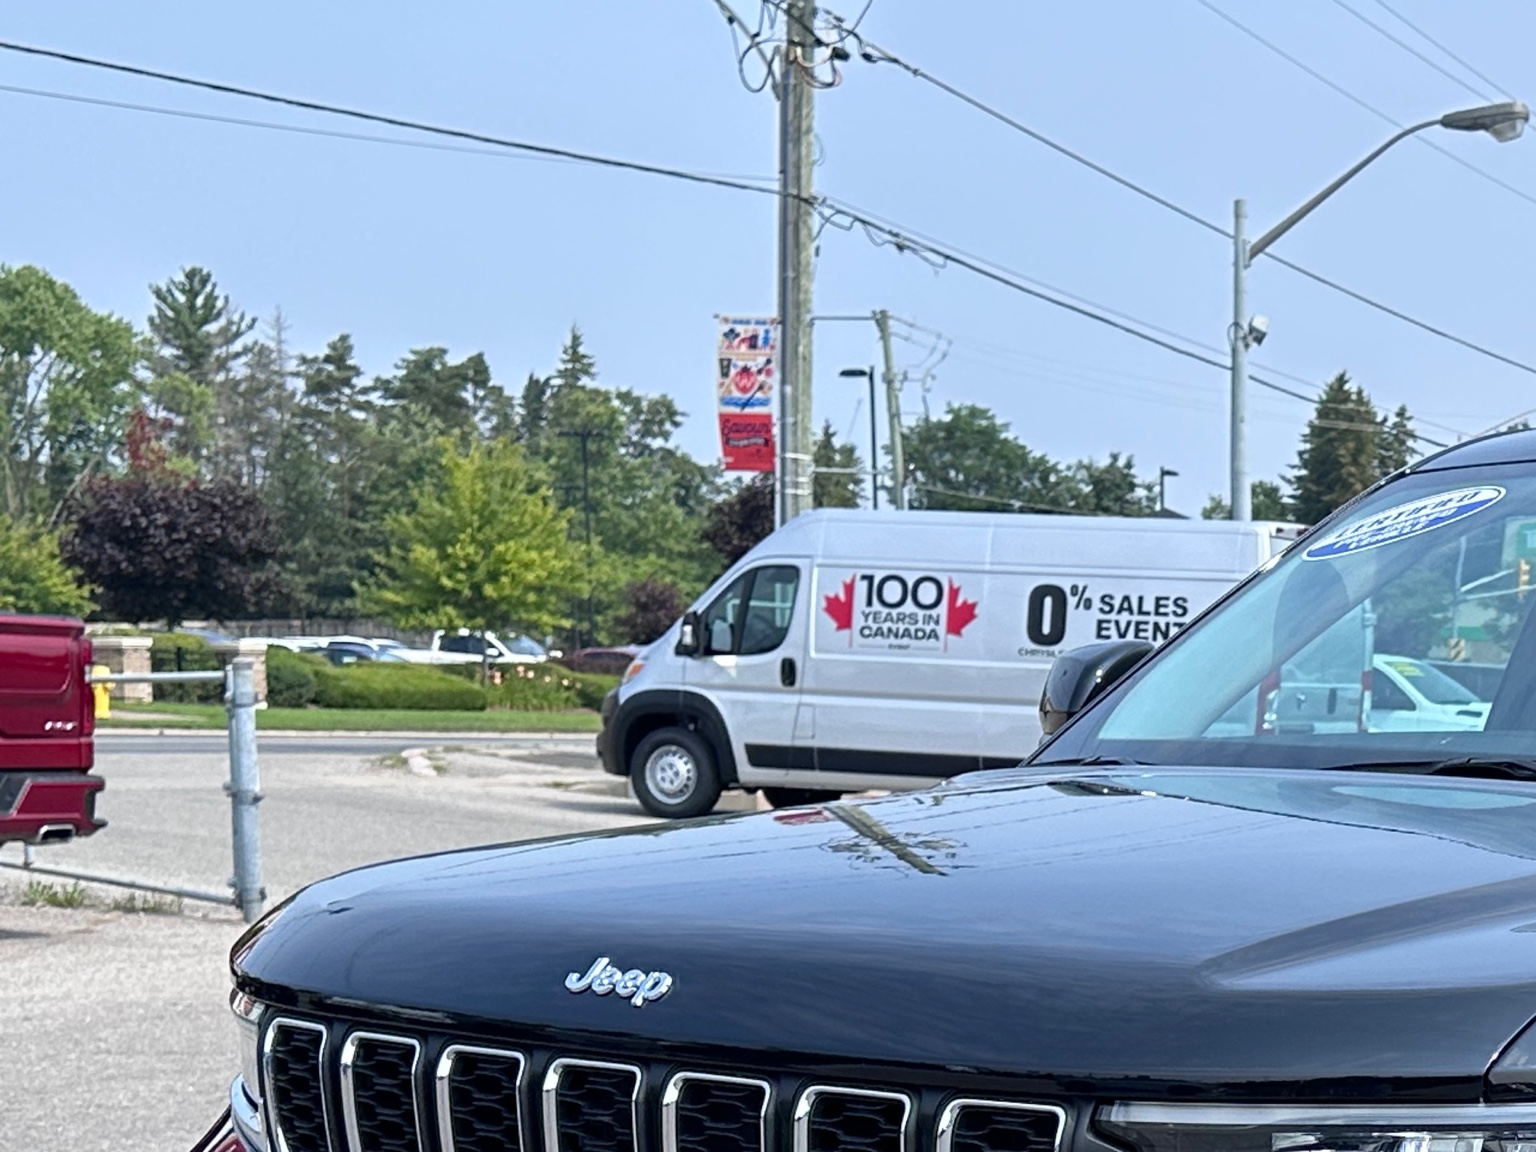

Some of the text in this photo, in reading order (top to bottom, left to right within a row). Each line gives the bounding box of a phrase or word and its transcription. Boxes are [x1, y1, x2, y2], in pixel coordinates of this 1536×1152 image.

[859, 574, 944, 611] 100
[1098, 594, 1189, 618] SALES
[861, 610, 941, 627] YEARS IN
[1026, 583, 1093, 647] 0%
[859, 625, 940, 642] CANADA
[564, 956, 673, 1008] Jeep
